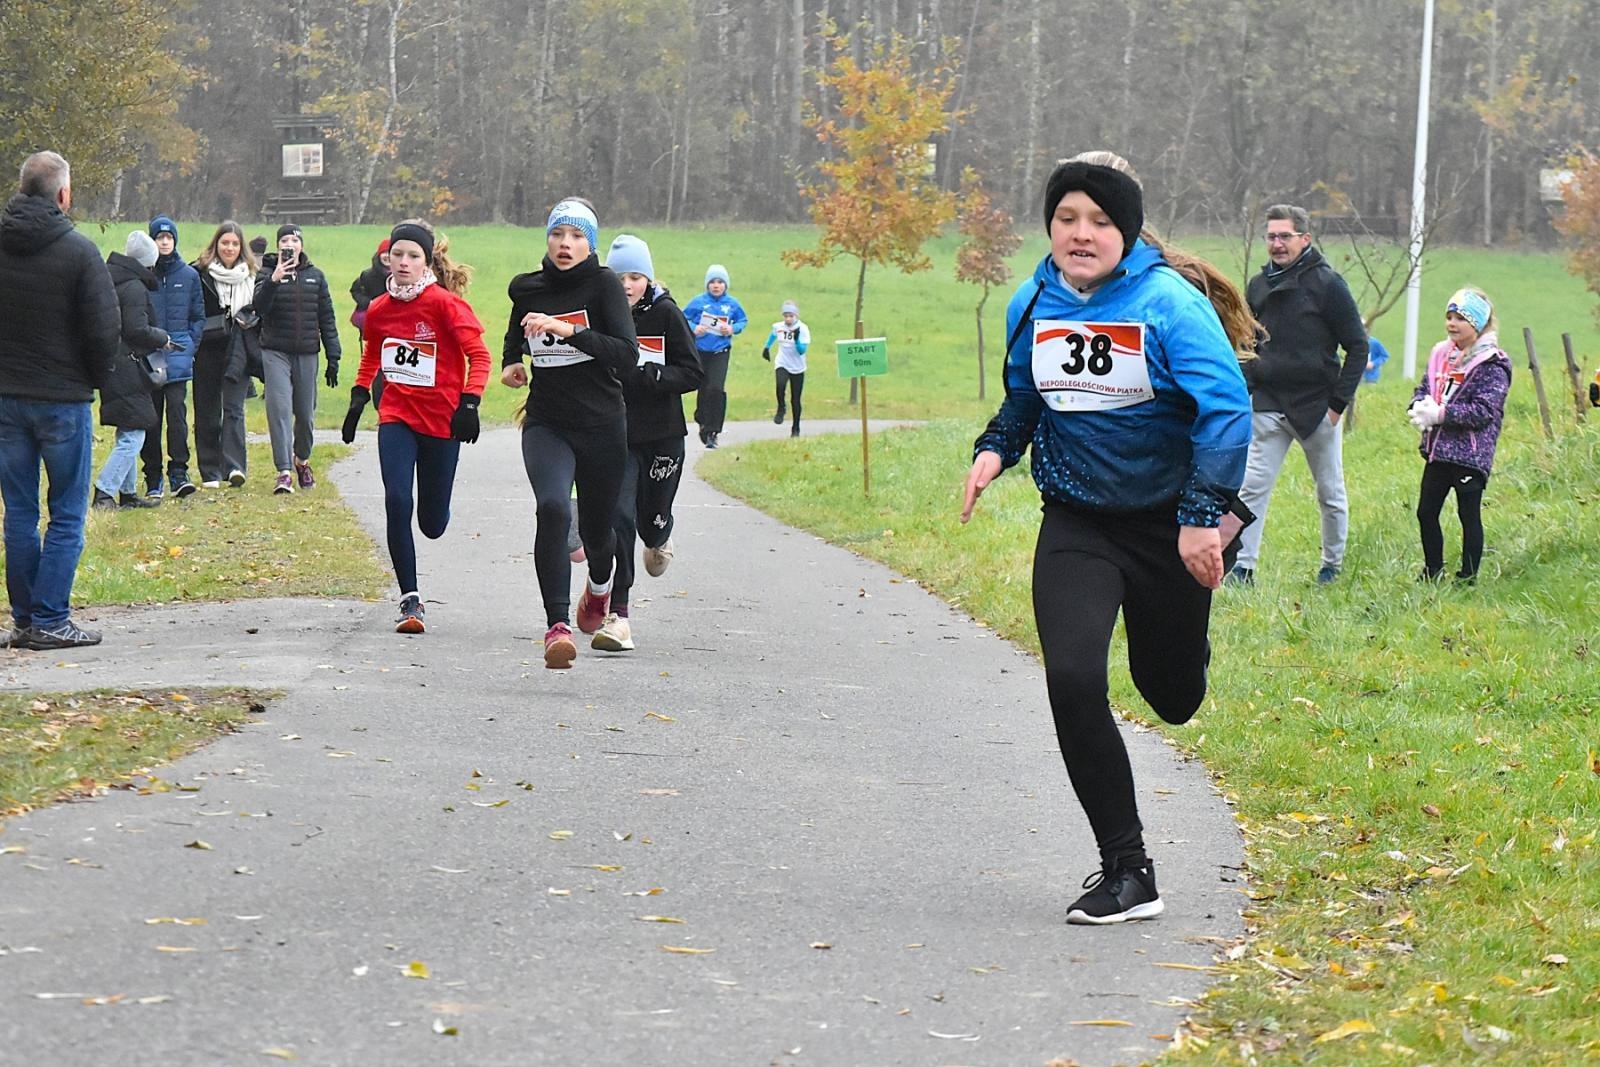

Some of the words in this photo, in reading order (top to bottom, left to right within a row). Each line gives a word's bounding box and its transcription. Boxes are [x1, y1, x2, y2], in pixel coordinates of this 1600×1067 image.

[710, 318, 718, 327] 3
[542, 331, 568, 347] 3
[394, 345, 420, 368] 84
[847, 345, 875, 354] START
[1061, 333, 1113, 376] 38
[1039, 379, 1115, 394] NIEPODLEGŁOŚCIOWA
[1116, 387, 1144, 396] PIĄTKA
